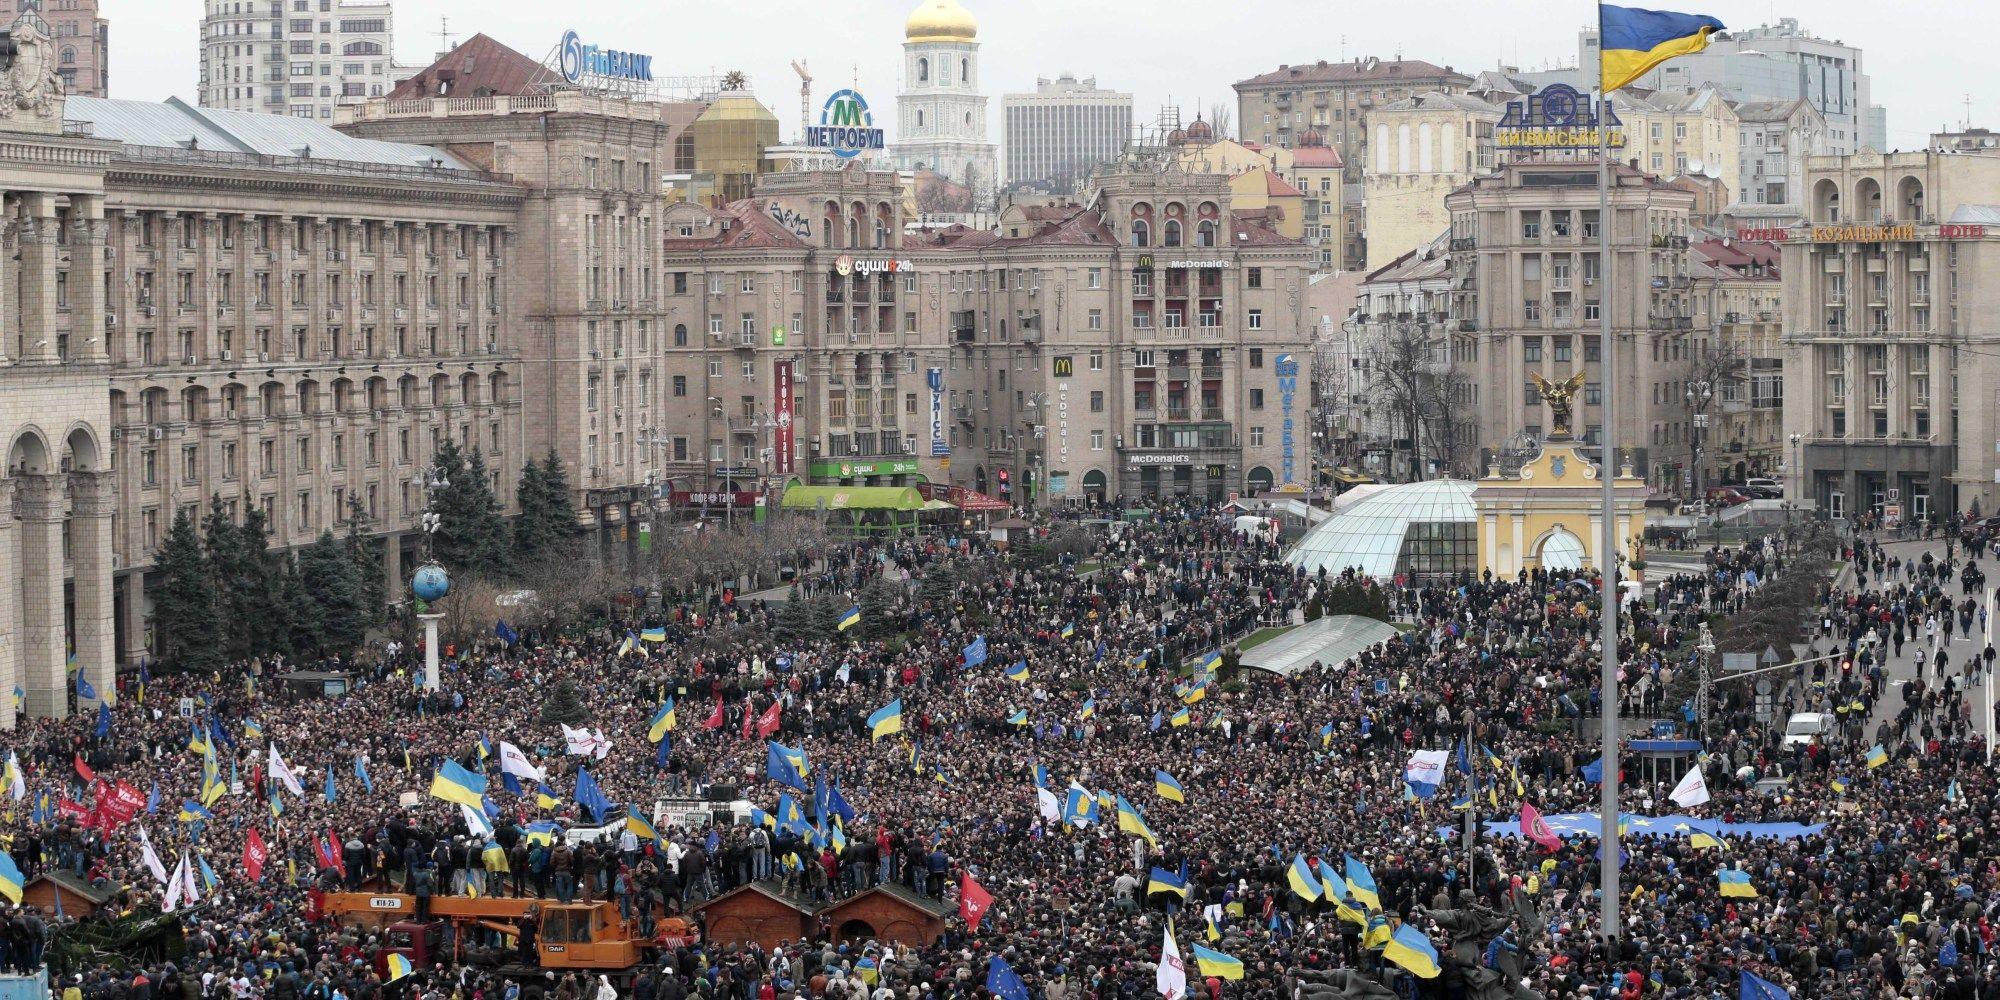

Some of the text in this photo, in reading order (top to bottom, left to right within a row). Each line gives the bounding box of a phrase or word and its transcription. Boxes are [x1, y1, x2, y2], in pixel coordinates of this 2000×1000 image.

[807, 126, 884, 149] МЕТРОБУД
[1737, 228, 1788, 241] ГОТЕЛЬ
[1814, 223, 1915, 243] КОЗАЦЬКИЙ
[1171, 260, 1229, 268] McDonald's
[1131, 454, 1189, 464] McDonald's
